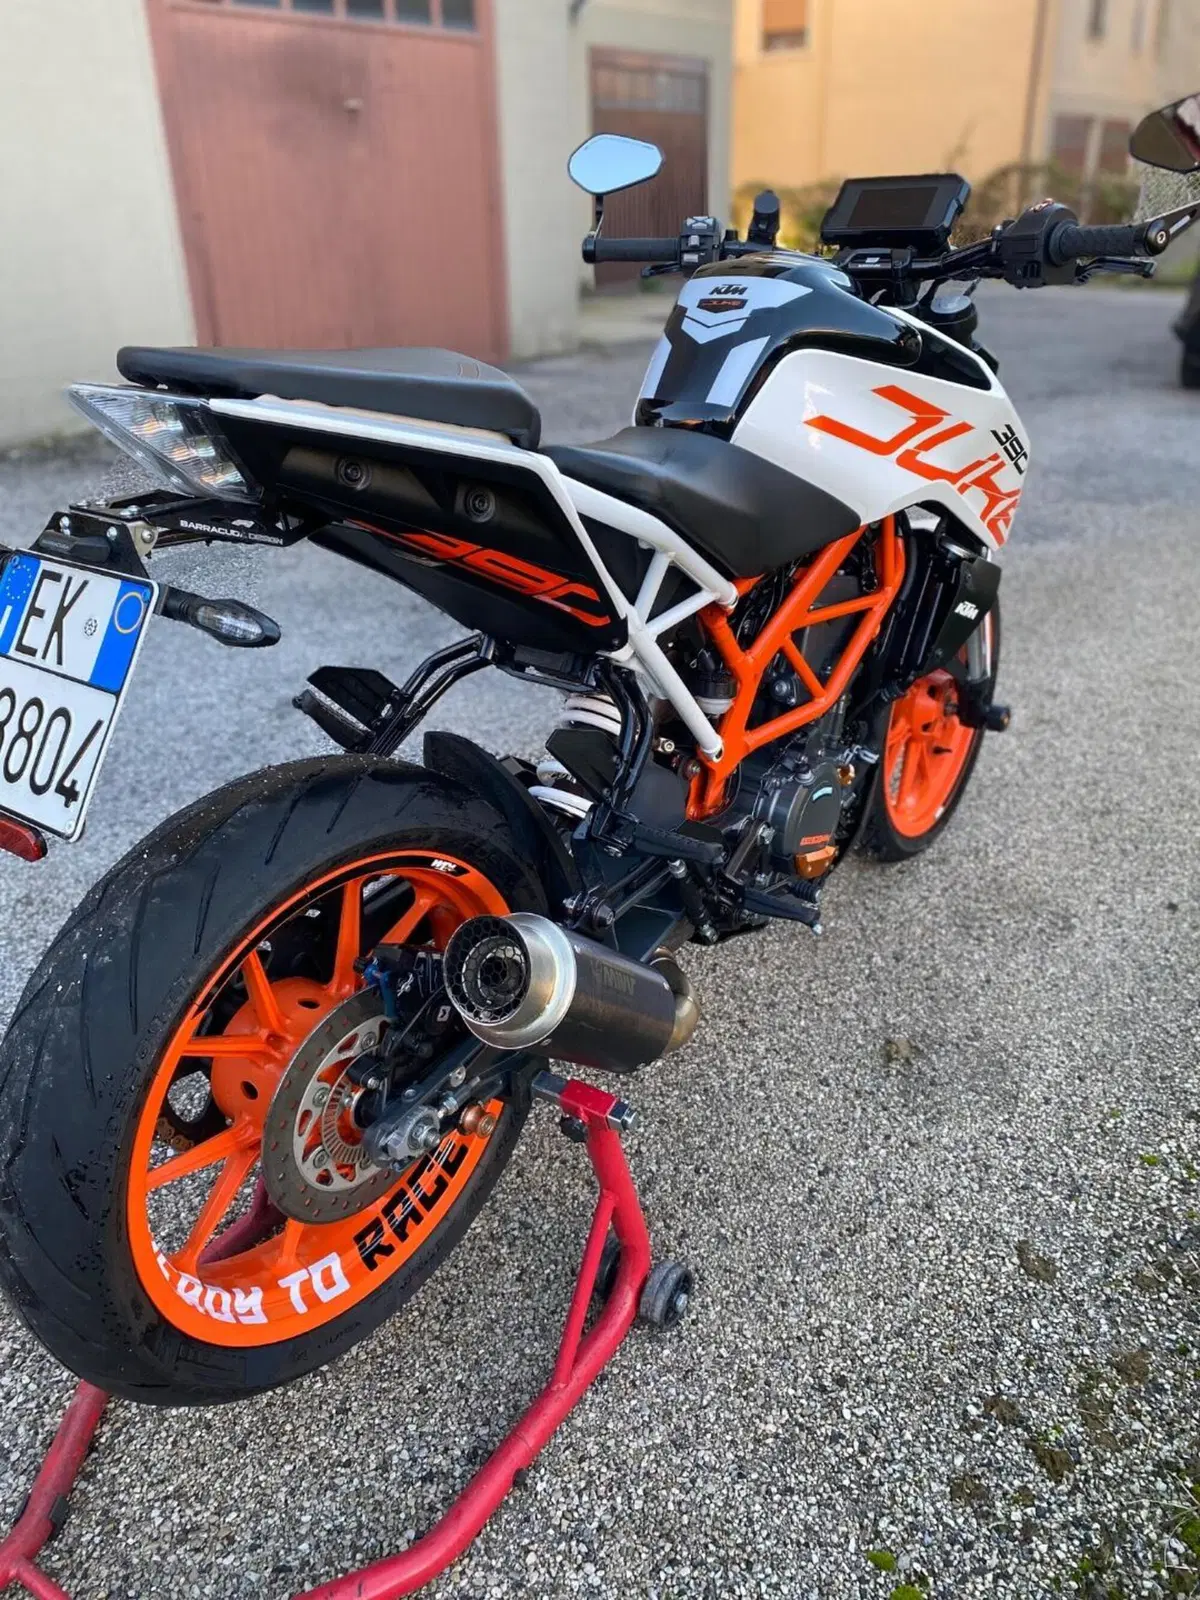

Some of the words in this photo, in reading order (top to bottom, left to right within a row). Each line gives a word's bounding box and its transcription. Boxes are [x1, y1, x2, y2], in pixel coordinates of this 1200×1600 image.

[708, 284, 748, 295] KTM
[14, 568, 90, 666] EK
[954, 600, 980, 620] KTM
[277, 1251, 351, 1314] TO
